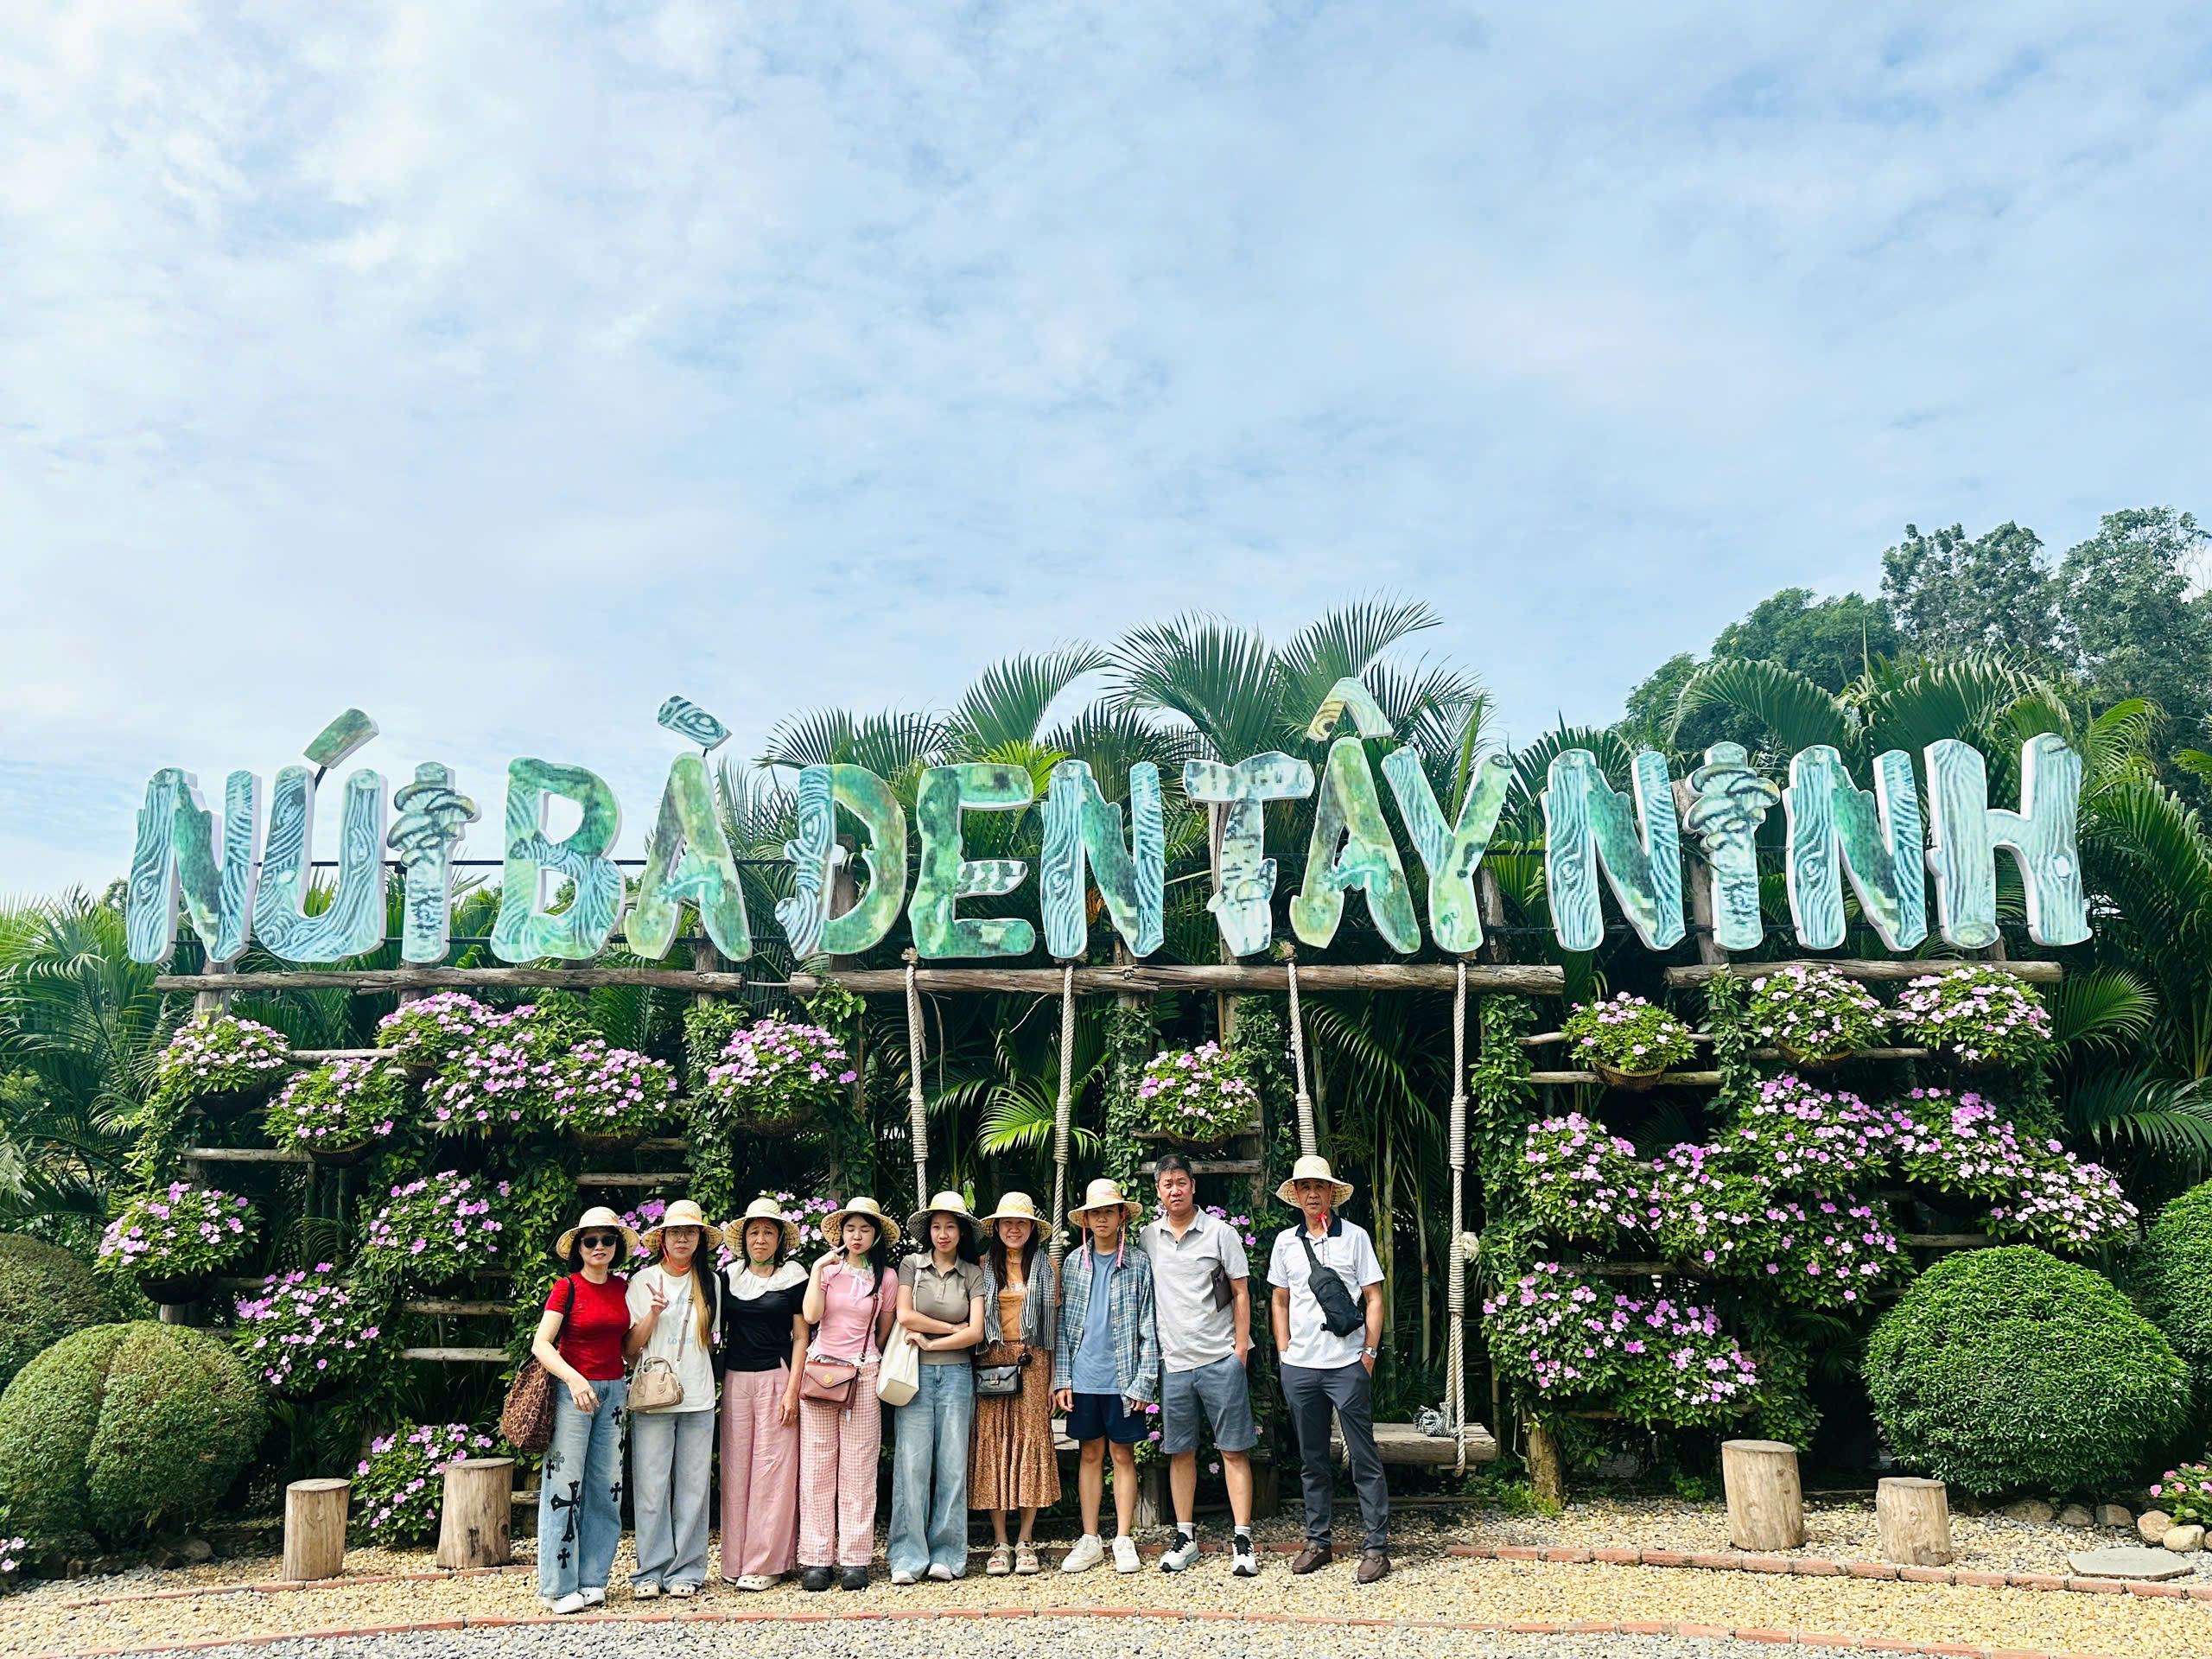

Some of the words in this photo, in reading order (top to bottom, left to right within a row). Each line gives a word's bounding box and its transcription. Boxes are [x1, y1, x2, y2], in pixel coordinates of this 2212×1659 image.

[127, 708, 482, 963] NÚI
[490, 696, 752, 962] BÀ
[1183, 677, 1515, 957] TÂY
[1541, 732, 2093, 951] NINH
